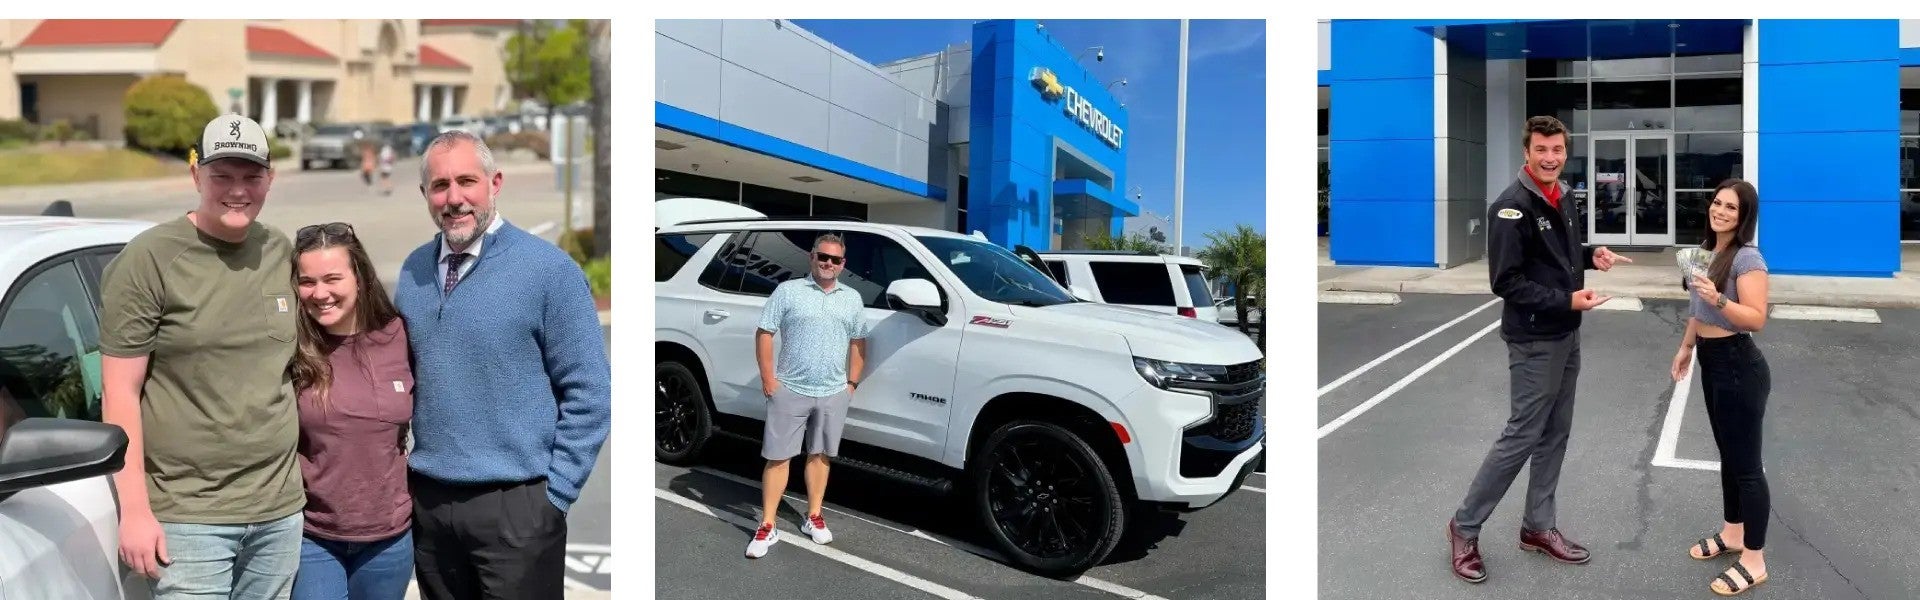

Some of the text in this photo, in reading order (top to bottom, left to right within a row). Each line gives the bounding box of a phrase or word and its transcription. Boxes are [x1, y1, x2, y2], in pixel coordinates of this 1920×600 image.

[1066, 86, 1123, 148] CHEVROLET
[1628, 121, 1635, 129] A
[214, 141, 257, 152] BROWNING
[910, 392, 947, 404] TAHOE
